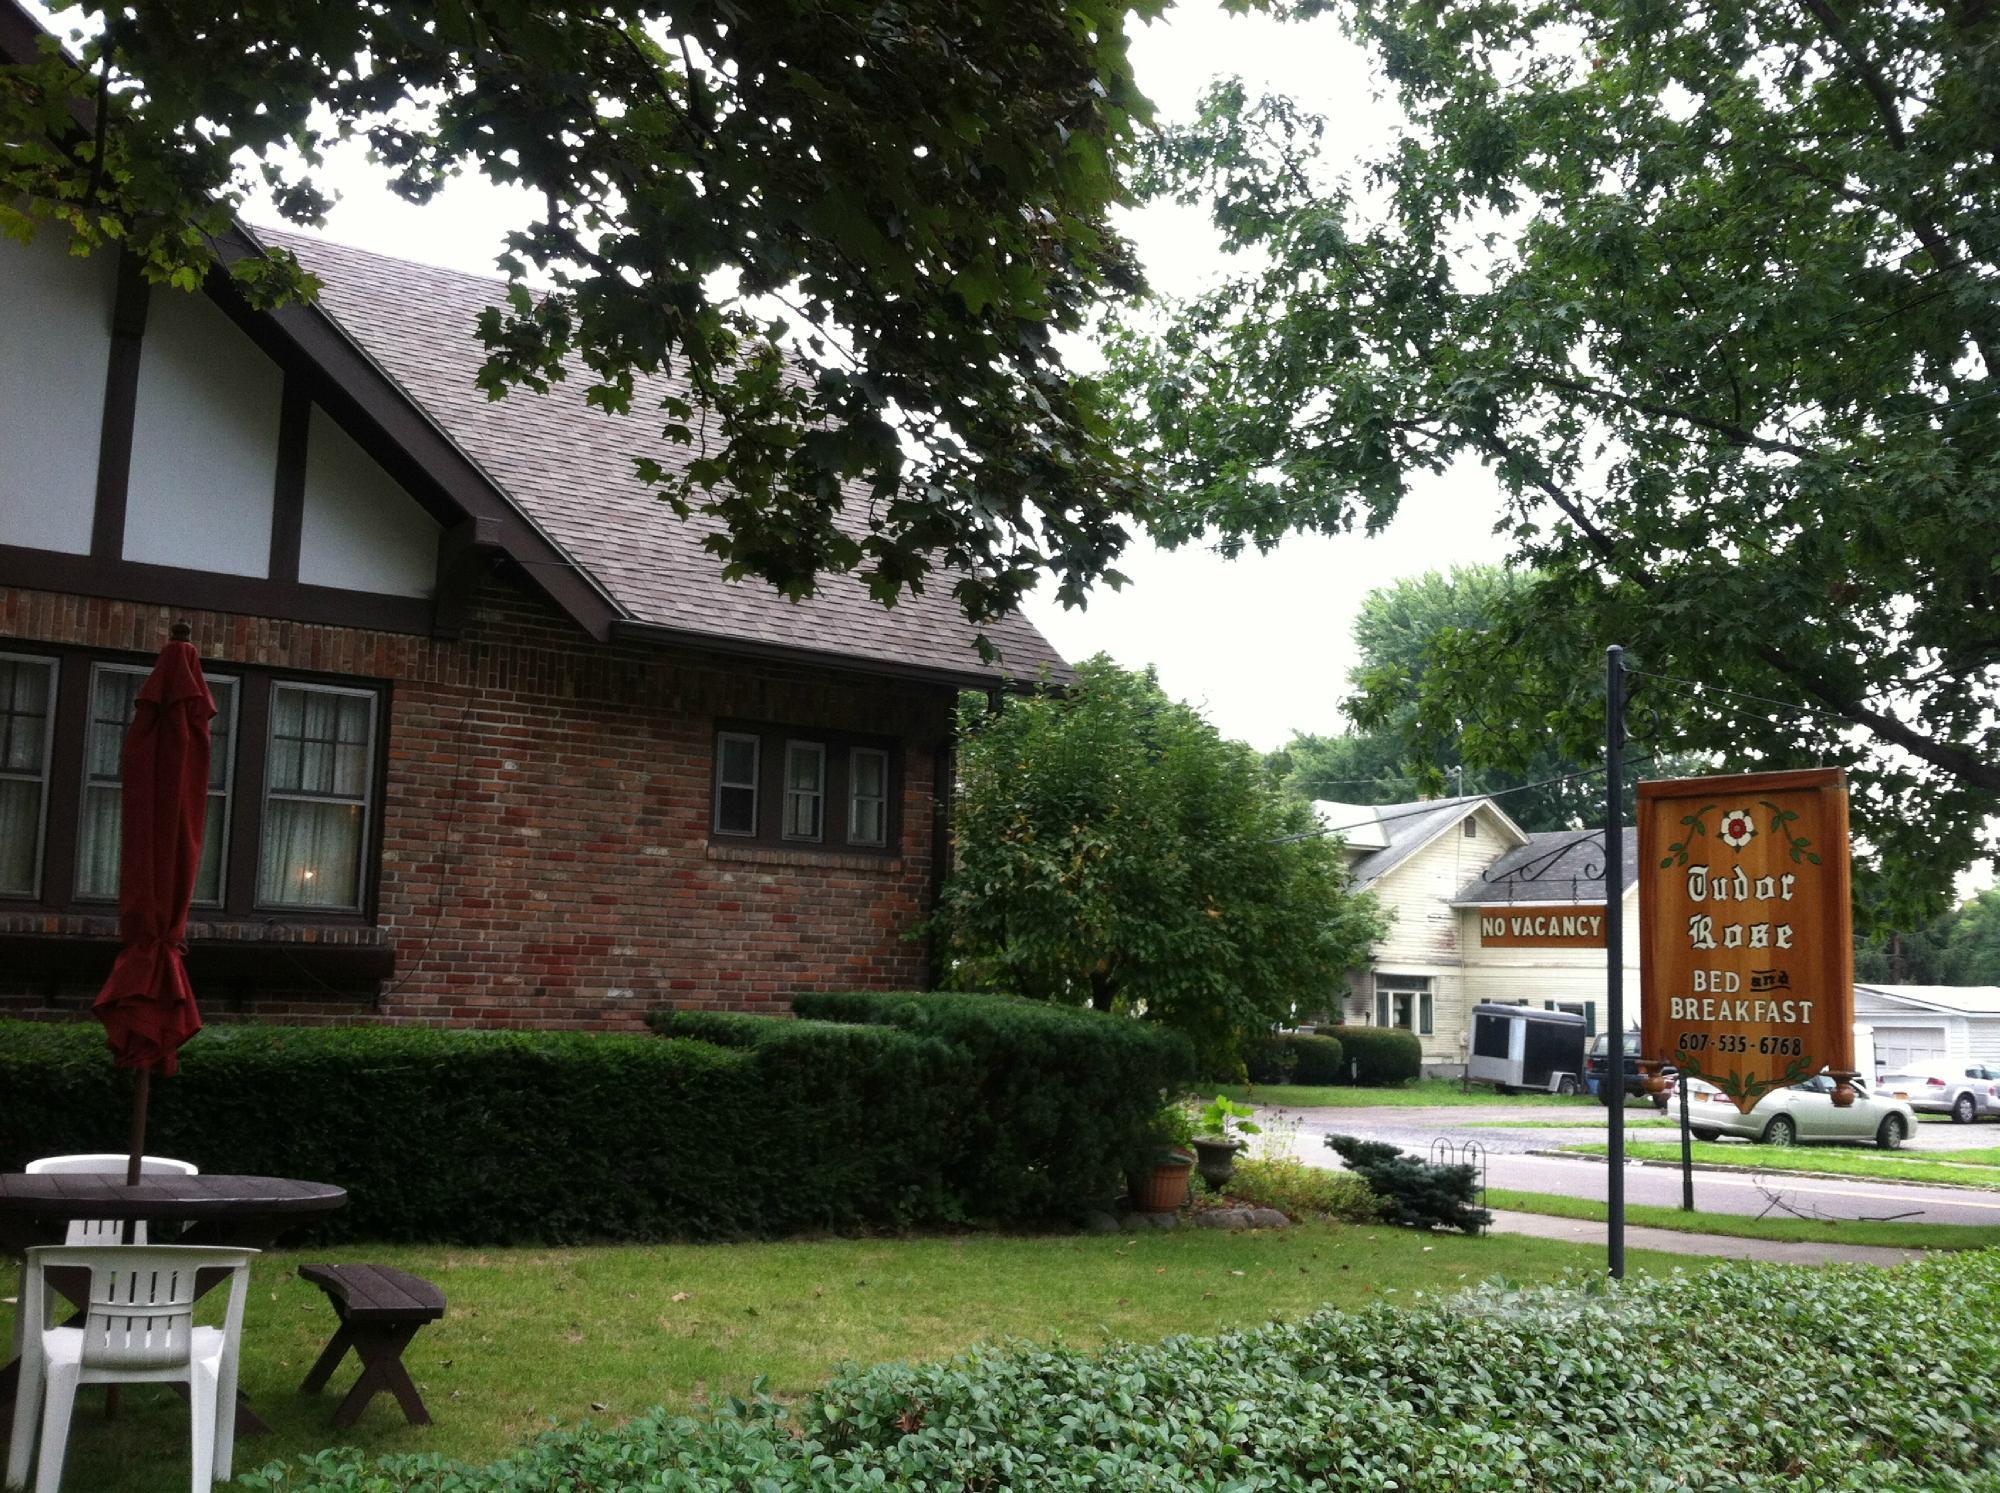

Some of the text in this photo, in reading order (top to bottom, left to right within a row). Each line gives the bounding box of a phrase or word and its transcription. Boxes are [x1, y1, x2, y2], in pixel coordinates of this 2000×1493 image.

[1688, 864, 1796, 901] Tudor
[1482, 916, 1601, 937] NO VACANCY
[1688, 914, 1793, 950] Rose
[1694, 970, 1740, 993] BED
[1671, 997, 1813, 1024] BREAKFAST
[1679, 1032, 1802, 1056] 607-535-6768
